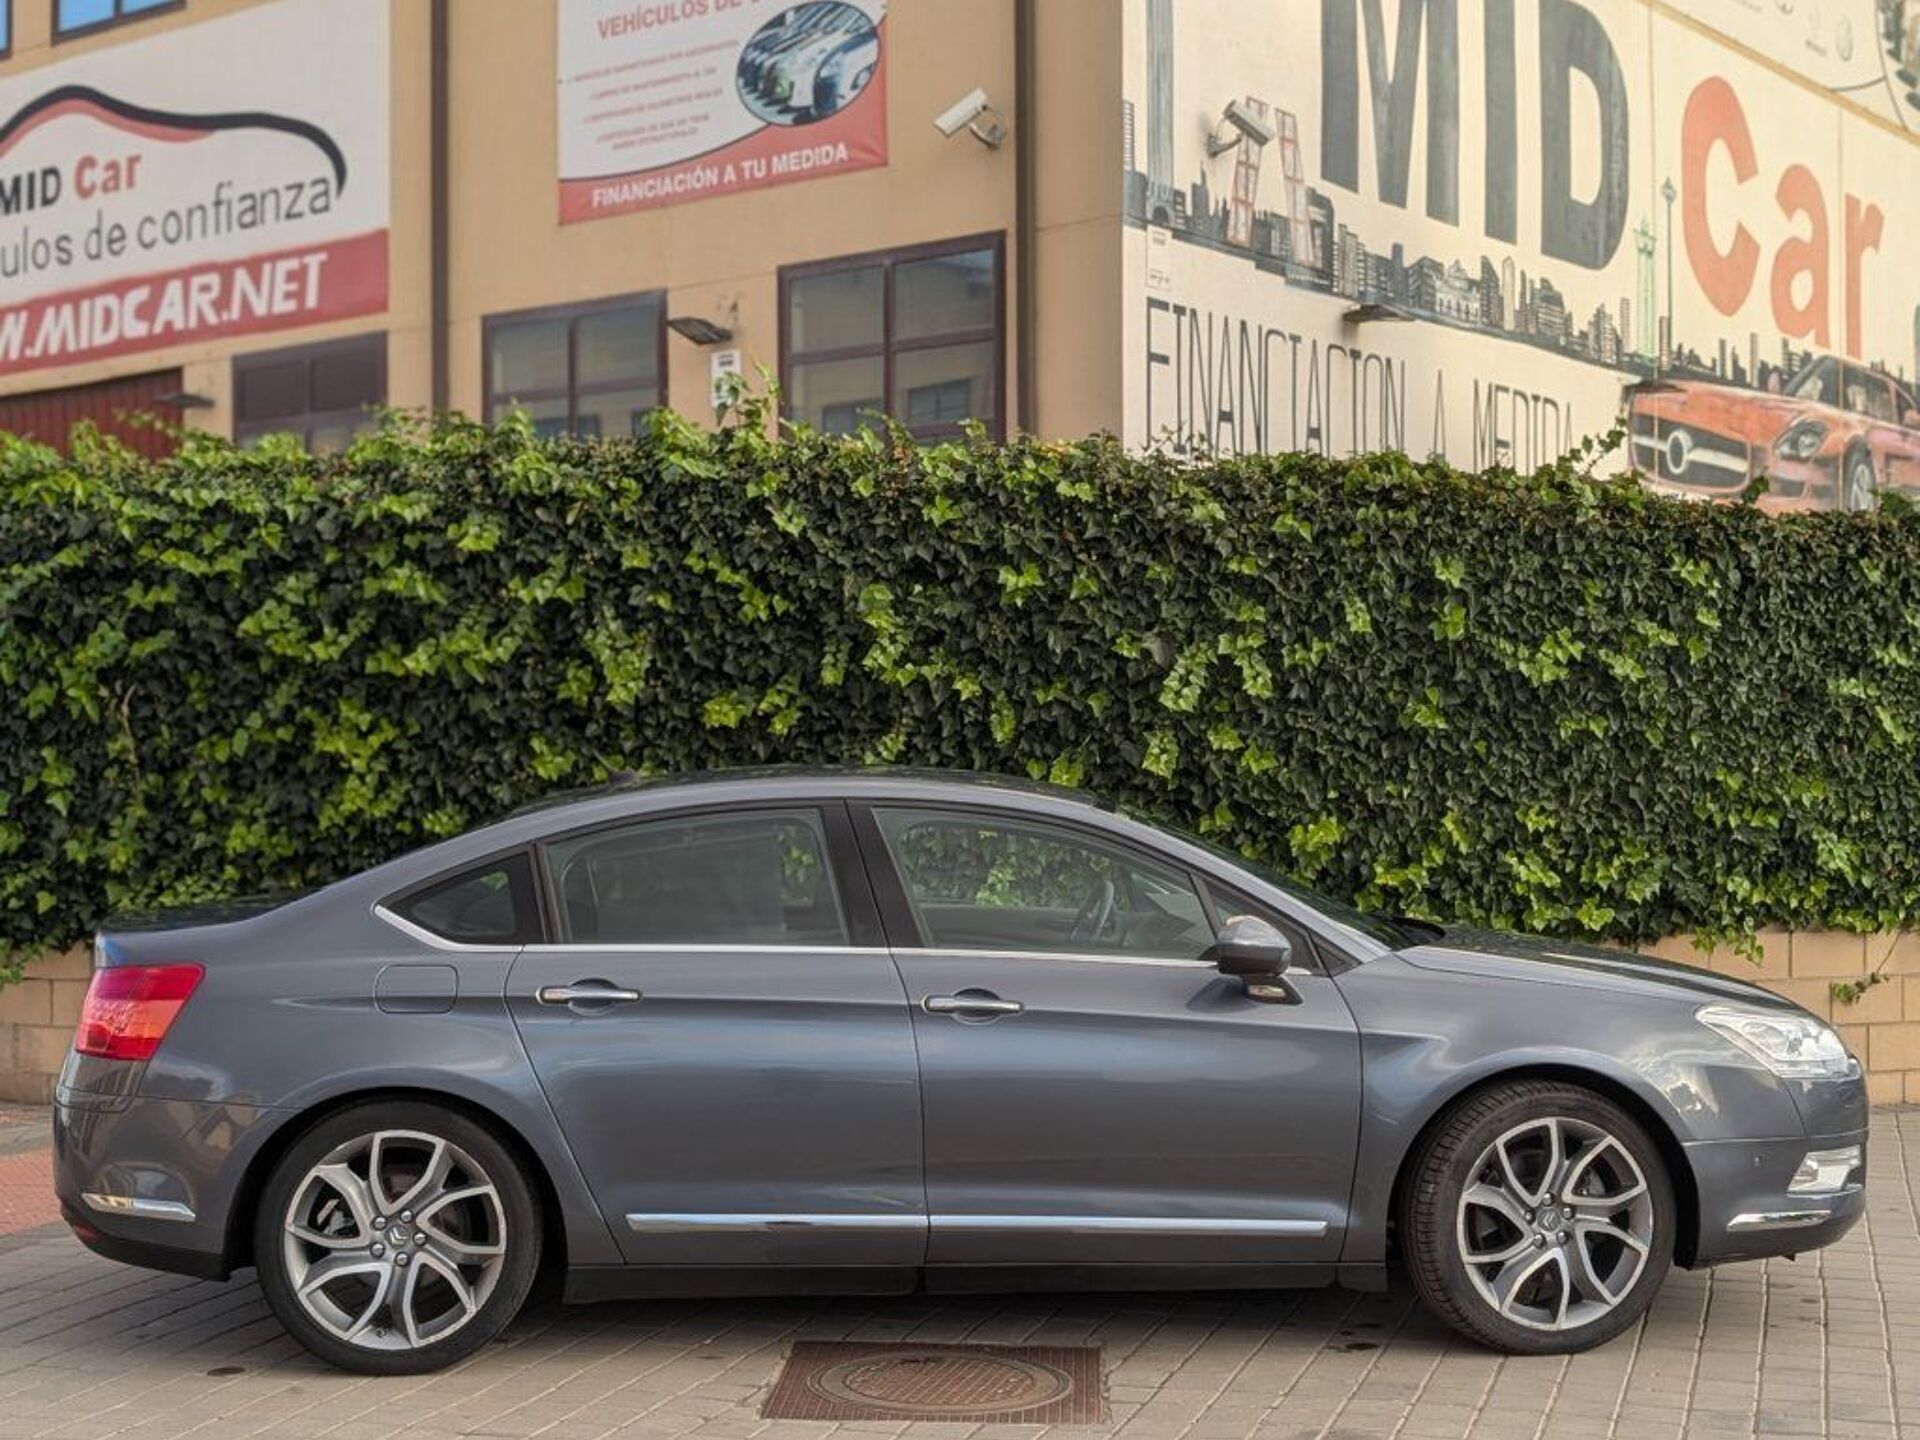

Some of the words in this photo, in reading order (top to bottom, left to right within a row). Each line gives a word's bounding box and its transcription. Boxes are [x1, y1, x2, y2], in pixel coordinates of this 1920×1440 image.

[0, 166, 62, 216] MID
[74, 153, 142, 199] Car
[592, 168, 719, 208] FINANCIACIÓN
[723, 162, 737, 183] A
[741, 155, 767, 180] TU
[771, 142, 849, 175] MEDIDA
[1321, 0, 1629, 271] MID
[1681, 75, 1885, 361] Car
[85, 208, 127, 260] de
[137, 176, 331, 250] confianza
